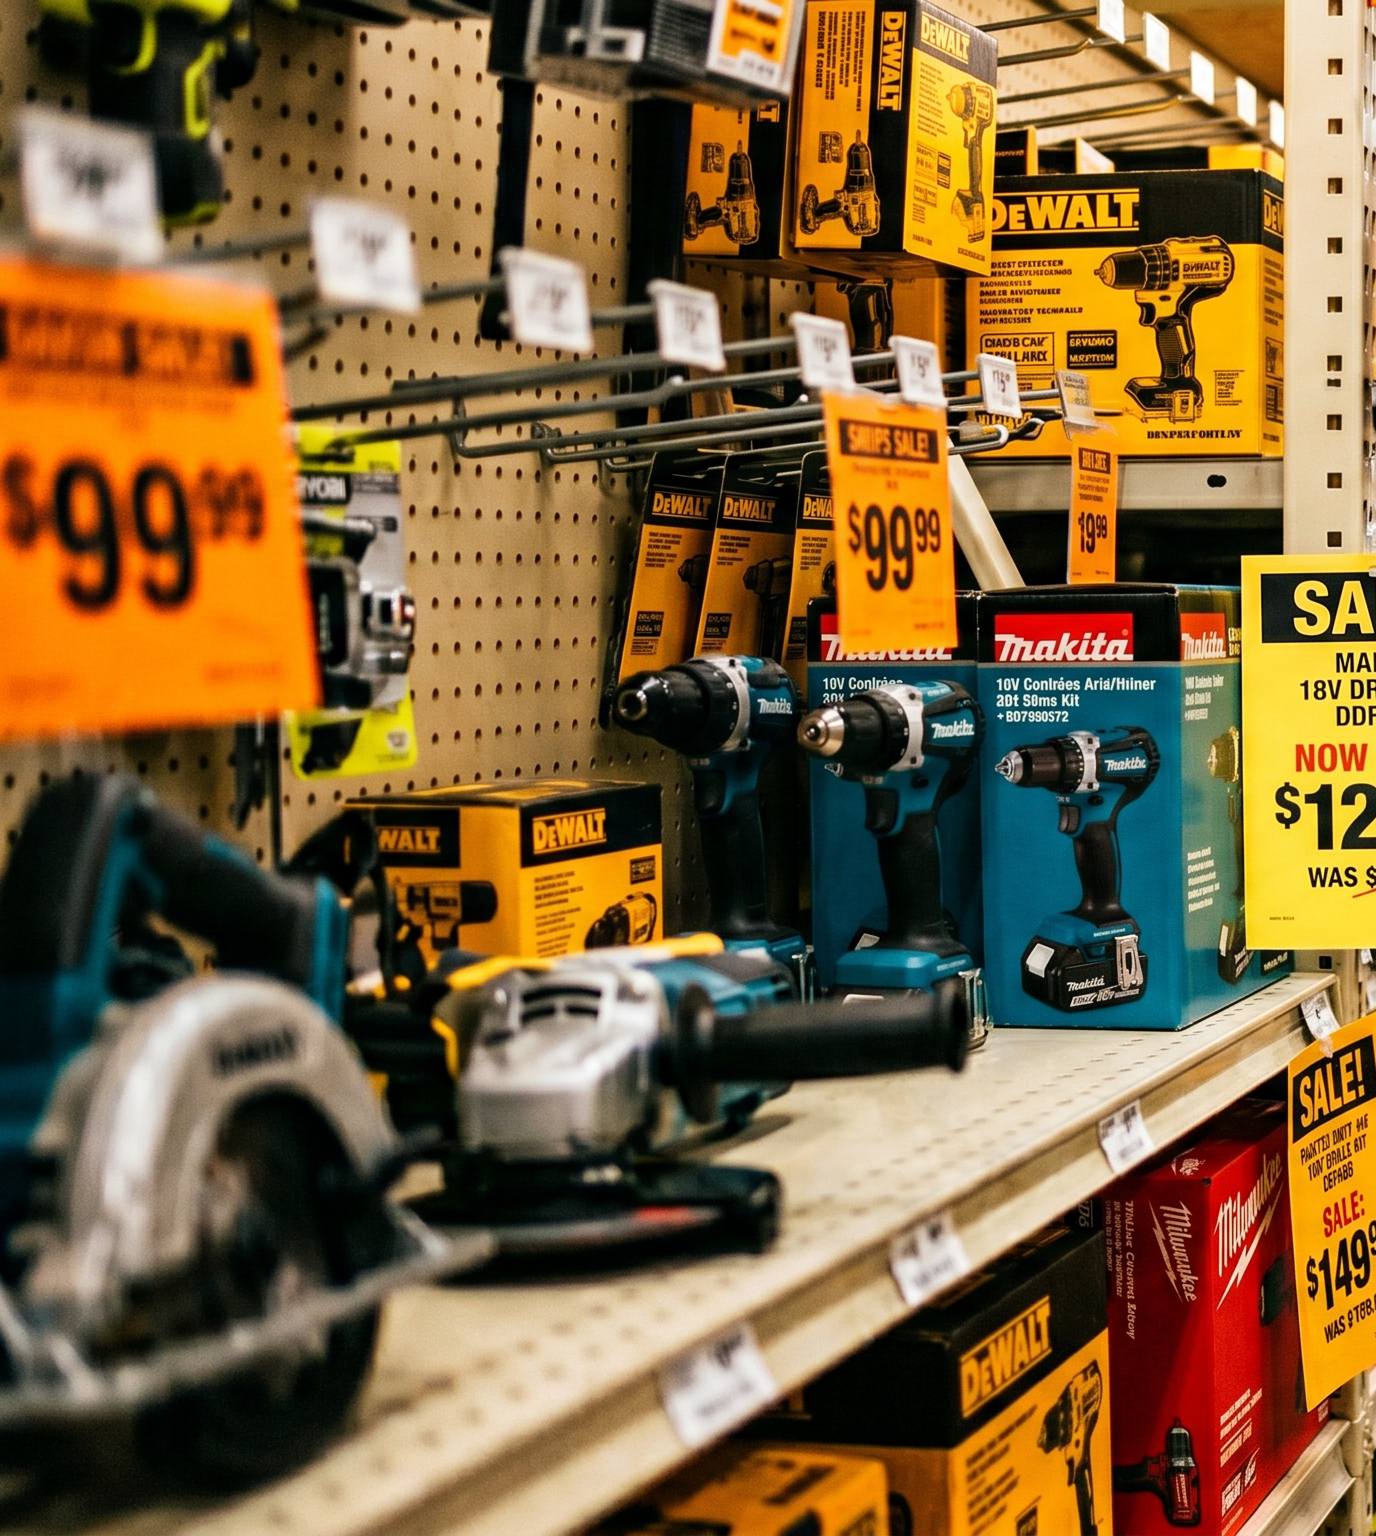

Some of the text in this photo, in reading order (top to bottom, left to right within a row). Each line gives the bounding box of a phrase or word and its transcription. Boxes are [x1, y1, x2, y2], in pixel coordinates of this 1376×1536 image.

[1299, 679, 1342, 700] 18V
[1295, 742, 1368, 773] NOW
[1308, 865, 1359, 889] WAS
[1299, 1047, 1366, 1128] SALE!
[1322, 1189, 1366, 1239] SALE:
[1323, 1314, 1347, 1344] WAS
